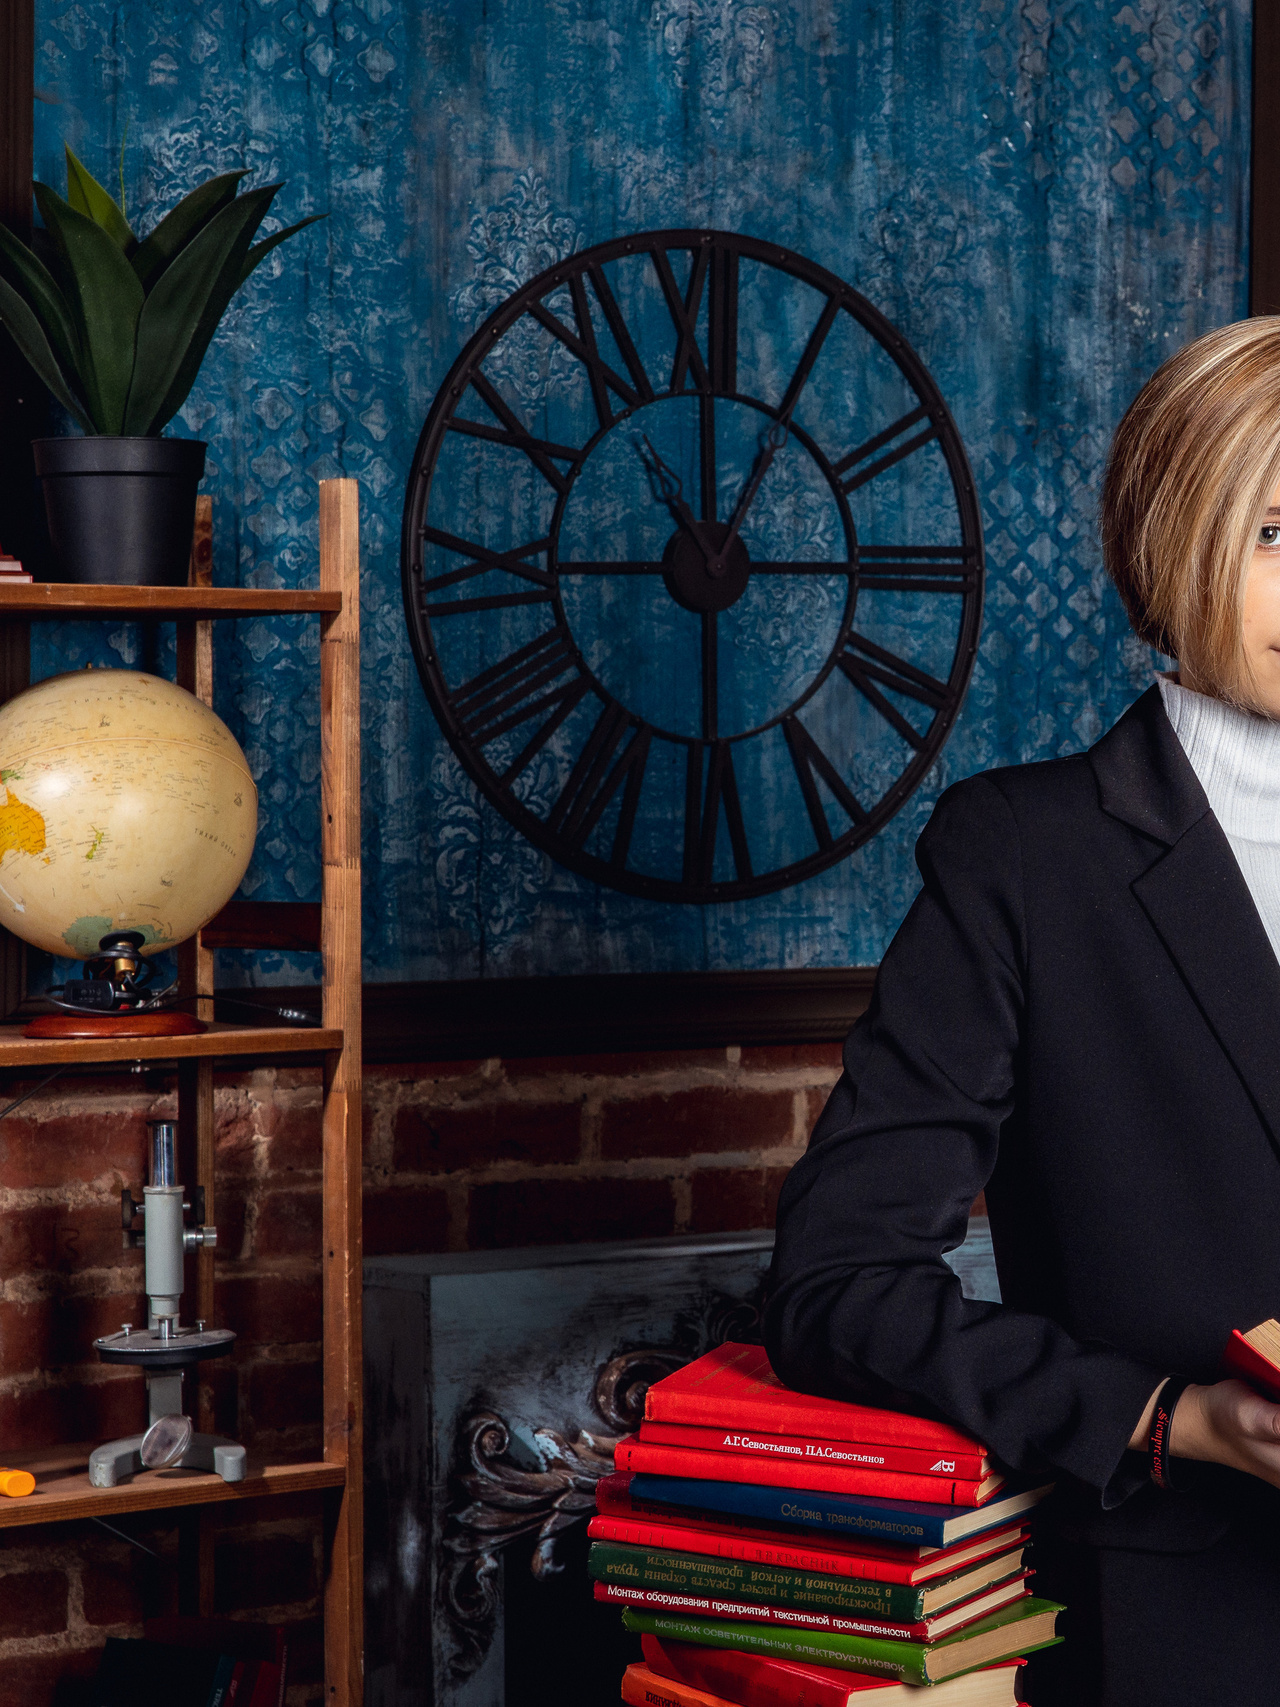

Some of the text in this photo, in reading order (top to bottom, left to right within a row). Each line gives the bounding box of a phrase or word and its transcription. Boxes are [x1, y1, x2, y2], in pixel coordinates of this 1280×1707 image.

[529, 268, 653, 427] XI
[651, 243, 739, 393] XII
[446, 368, 584, 494] X
[832, 405, 944, 494] II
[424, 526, 558, 617] IX
[858, 545, 976, 593] III
[450, 625, 596, 790] VIII
[681, 740, 754, 885] VI
[782, 716, 868, 852] V
[805, 1445, 885, 1464] П.А.Севостьянов
[1151, 1407, 1169, 1455] Siempre
[780, 1503, 823, 1521] Сборка
[826, 1513, 924, 1536] трансформаторов
[606, 1564, 891, 1615] Проектирование и расчет средств охраны труда
[607, 1585, 911, 1638] Монтаж оборудования предприятий текстильной промышленности
[647, 1556, 892, 1598] в текстильной и легкой промышленности
[655, 1619, 905, 1672] МОНТАЖ ОСВЕТИТЕЛЬНЫХ ЭЛЕКТРОУСТАНОВОК
